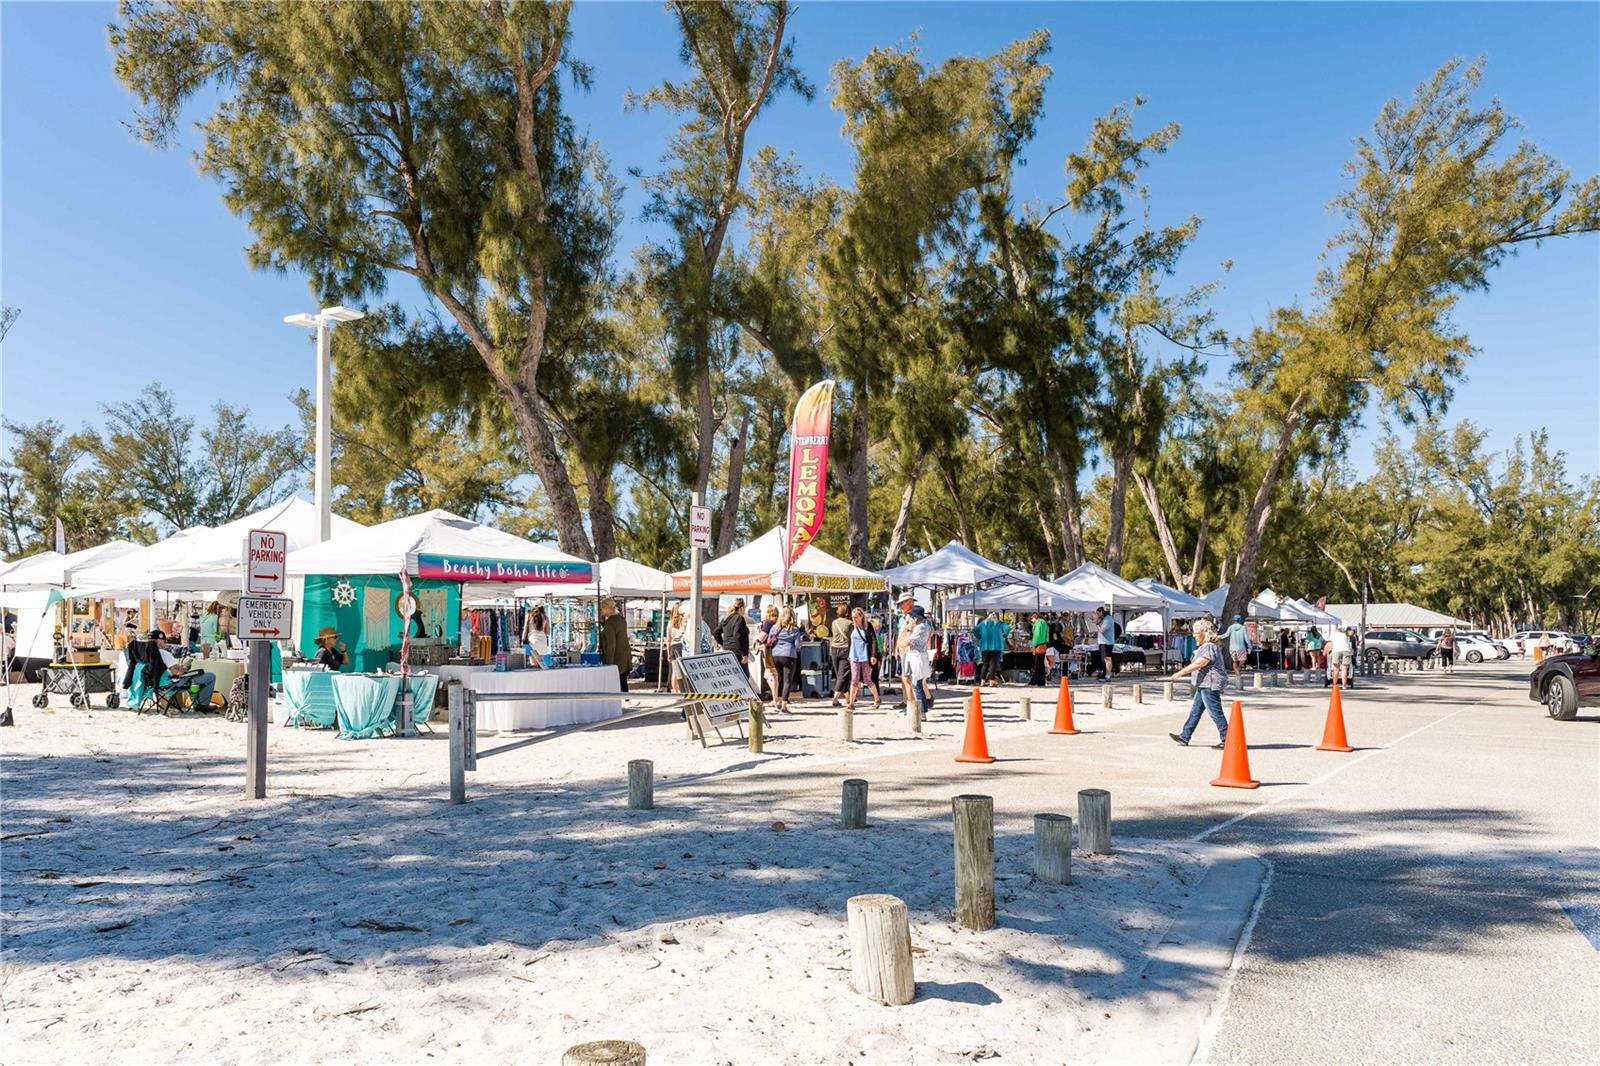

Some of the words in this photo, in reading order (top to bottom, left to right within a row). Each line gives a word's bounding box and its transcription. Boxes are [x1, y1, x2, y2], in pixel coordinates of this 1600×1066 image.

[697, 512, 705, 521] NO
[691, 525, 710, 534] PARKING
[260, 537, 275, 549] NO
[251, 549, 284, 563] PARKING
[443, 559, 491, 580] Beachy
[497, 562, 529, 577] Boho
[534, 565, 557, 578] Life
[792, 572, 814, 588] FRESH
[816, 575, 849, 590] SQUEEZED
[852, 576, 885, 590] LEMONADE
[245, 600, 287, 611] EMERGENCY
[248, 610, 282, 619] VEHICLES
[253, 619, 272, 628] ONLY
[689, 662, 697, 670] NO
[709, 657, 731, 667] ALLOWED
[691, 673, 700, 681] ON
[715, 668, 731, 678] BEACH
[718, 679, 732, 688] PARK
